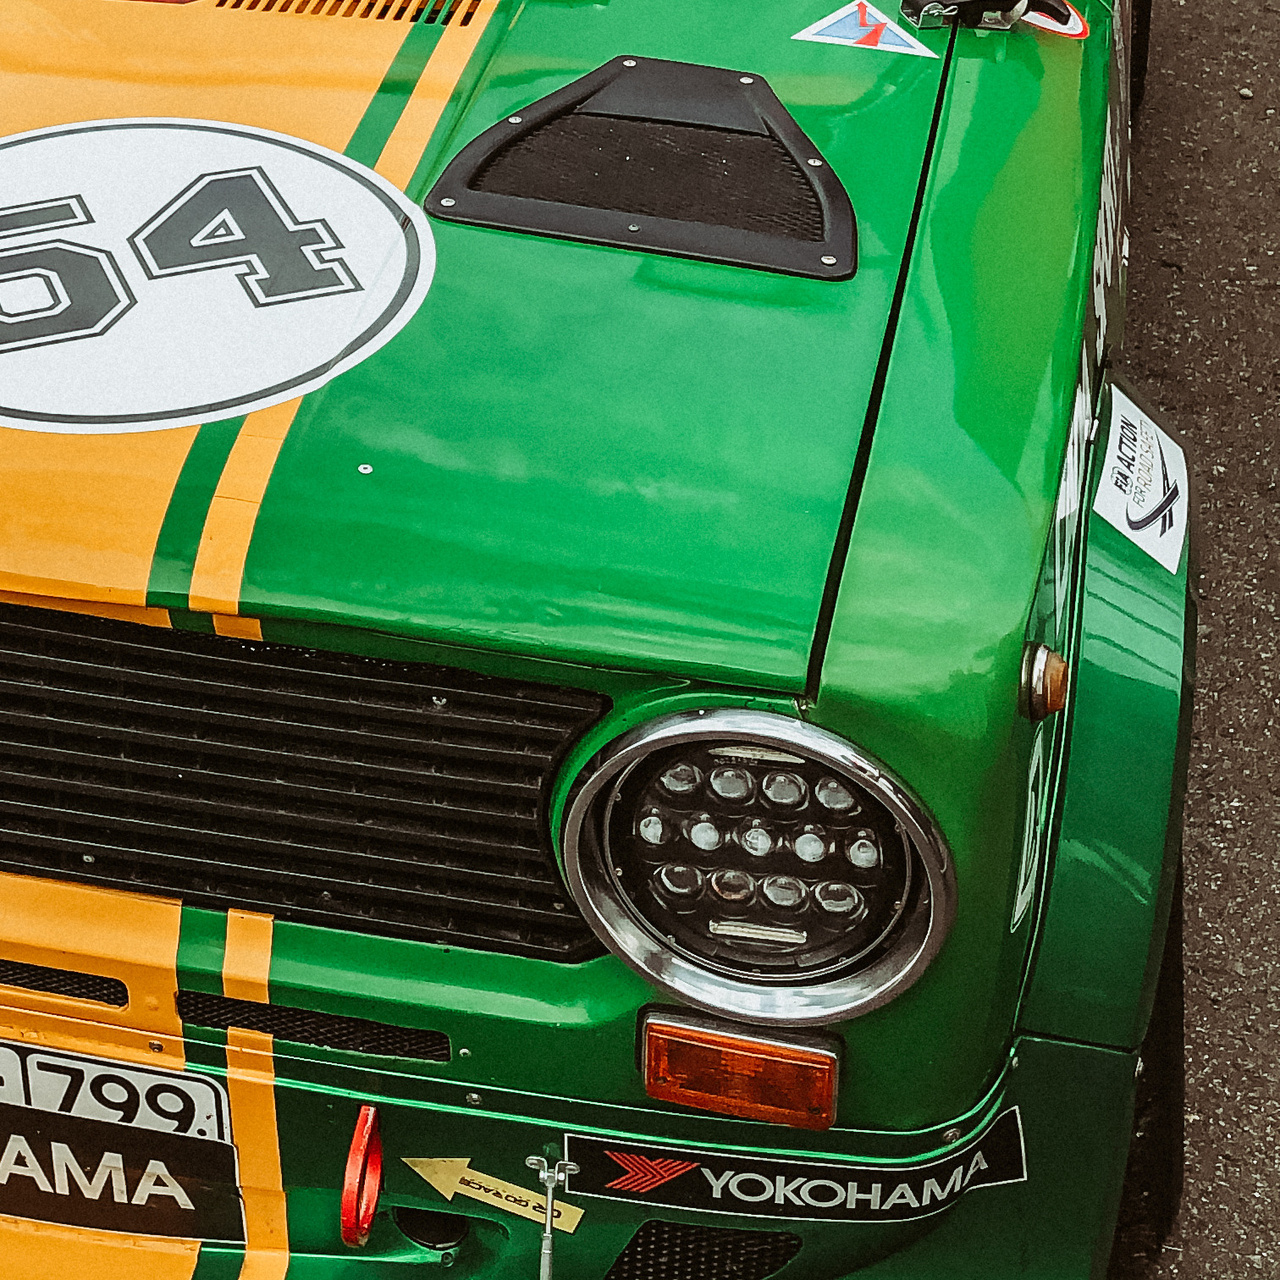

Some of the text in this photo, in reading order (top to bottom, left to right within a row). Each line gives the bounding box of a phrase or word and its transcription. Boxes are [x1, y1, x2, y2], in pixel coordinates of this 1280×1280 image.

[1116, 413, 1138, 475] ACTION
[35, 1060, 197, 1134] 799
[700, 1150, 989, 1211] YOKOHAMA
